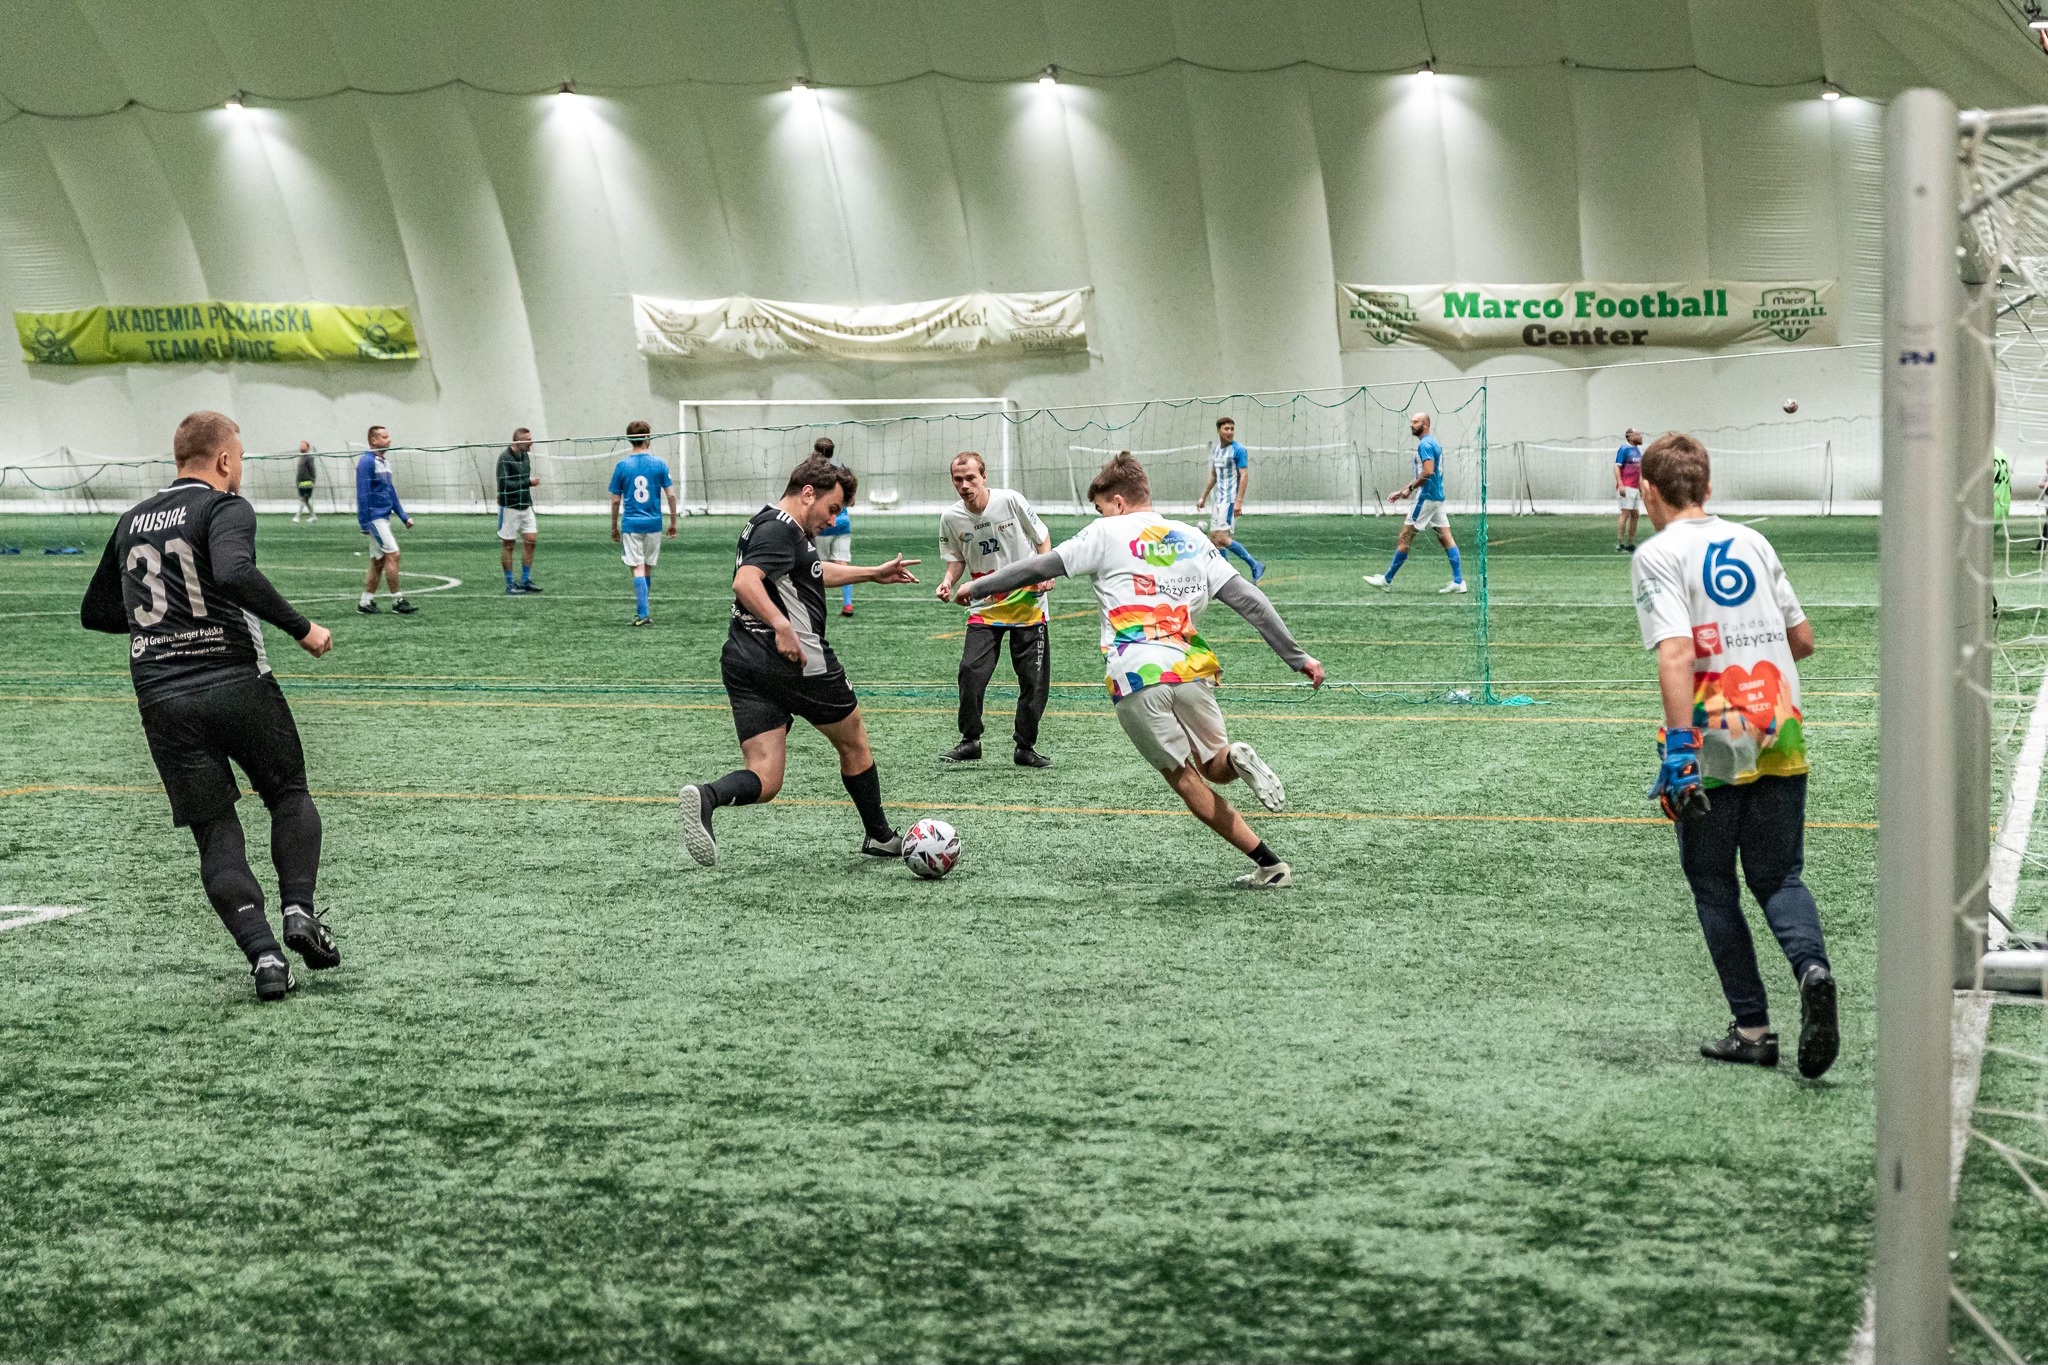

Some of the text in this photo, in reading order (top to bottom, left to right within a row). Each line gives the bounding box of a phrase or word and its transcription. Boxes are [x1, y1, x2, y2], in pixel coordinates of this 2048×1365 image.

[1350, 308, 1420, 322] FOALL
[1443, 288, 1729, 319] Marco Football
[1753, 307, 1827, 319] FOOTBALL
[106, 306, 204, 332] AKADEMIA
[1523, 323, 1649, 347] Center
[146, 338, 201, 360] TEAM
[634, 475, 649, 503] 8
[129, 506, 187, 535] MUSIAŁ
[979, 538, 1000, 555] 22
[126, 538, 208, 627] 31
[1702, 537, 1756, 607] 6
[199, 626, 224, 637] Polska
